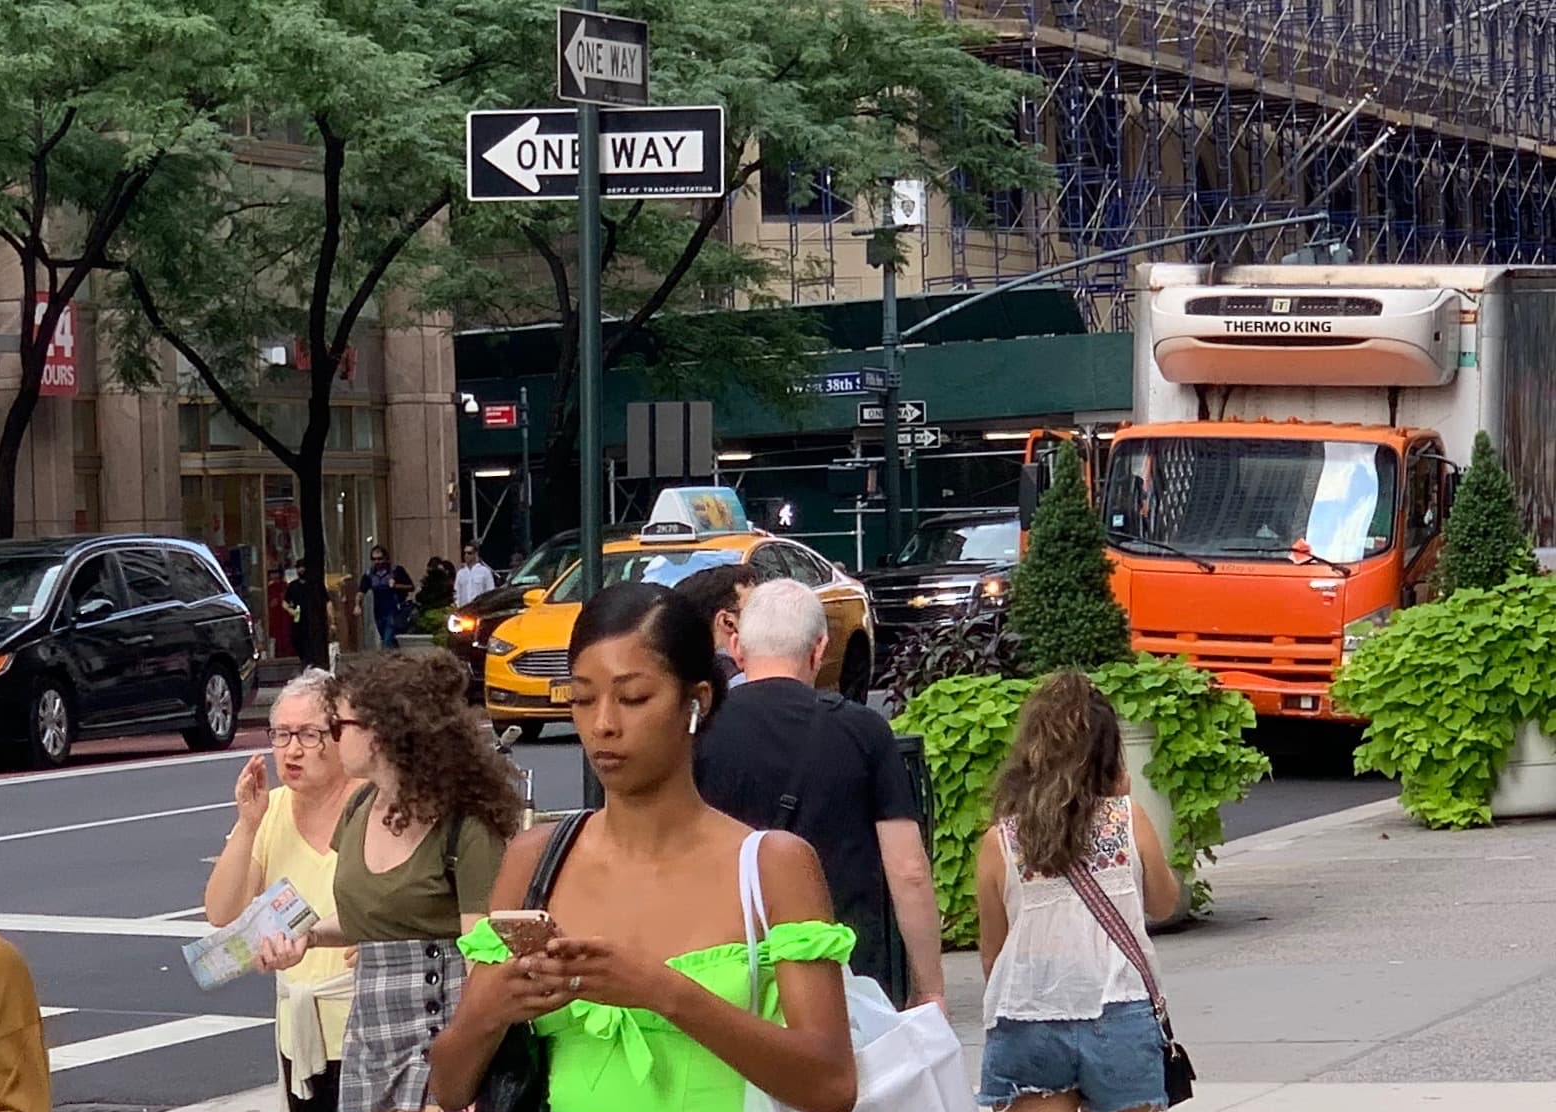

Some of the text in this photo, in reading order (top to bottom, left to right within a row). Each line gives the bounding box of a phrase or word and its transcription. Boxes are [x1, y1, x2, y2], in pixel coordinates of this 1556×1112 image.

[577, 40, 637, 84] ONE WAY
[611, 136, 686, 169] WAY
[643, 185, 713, 193] TRANSPORTATION
[1224, 320, 1332, 333] THERMO KING
[41, 363, 75, 387] OURS
[825, 377, 853, 393] 38th
